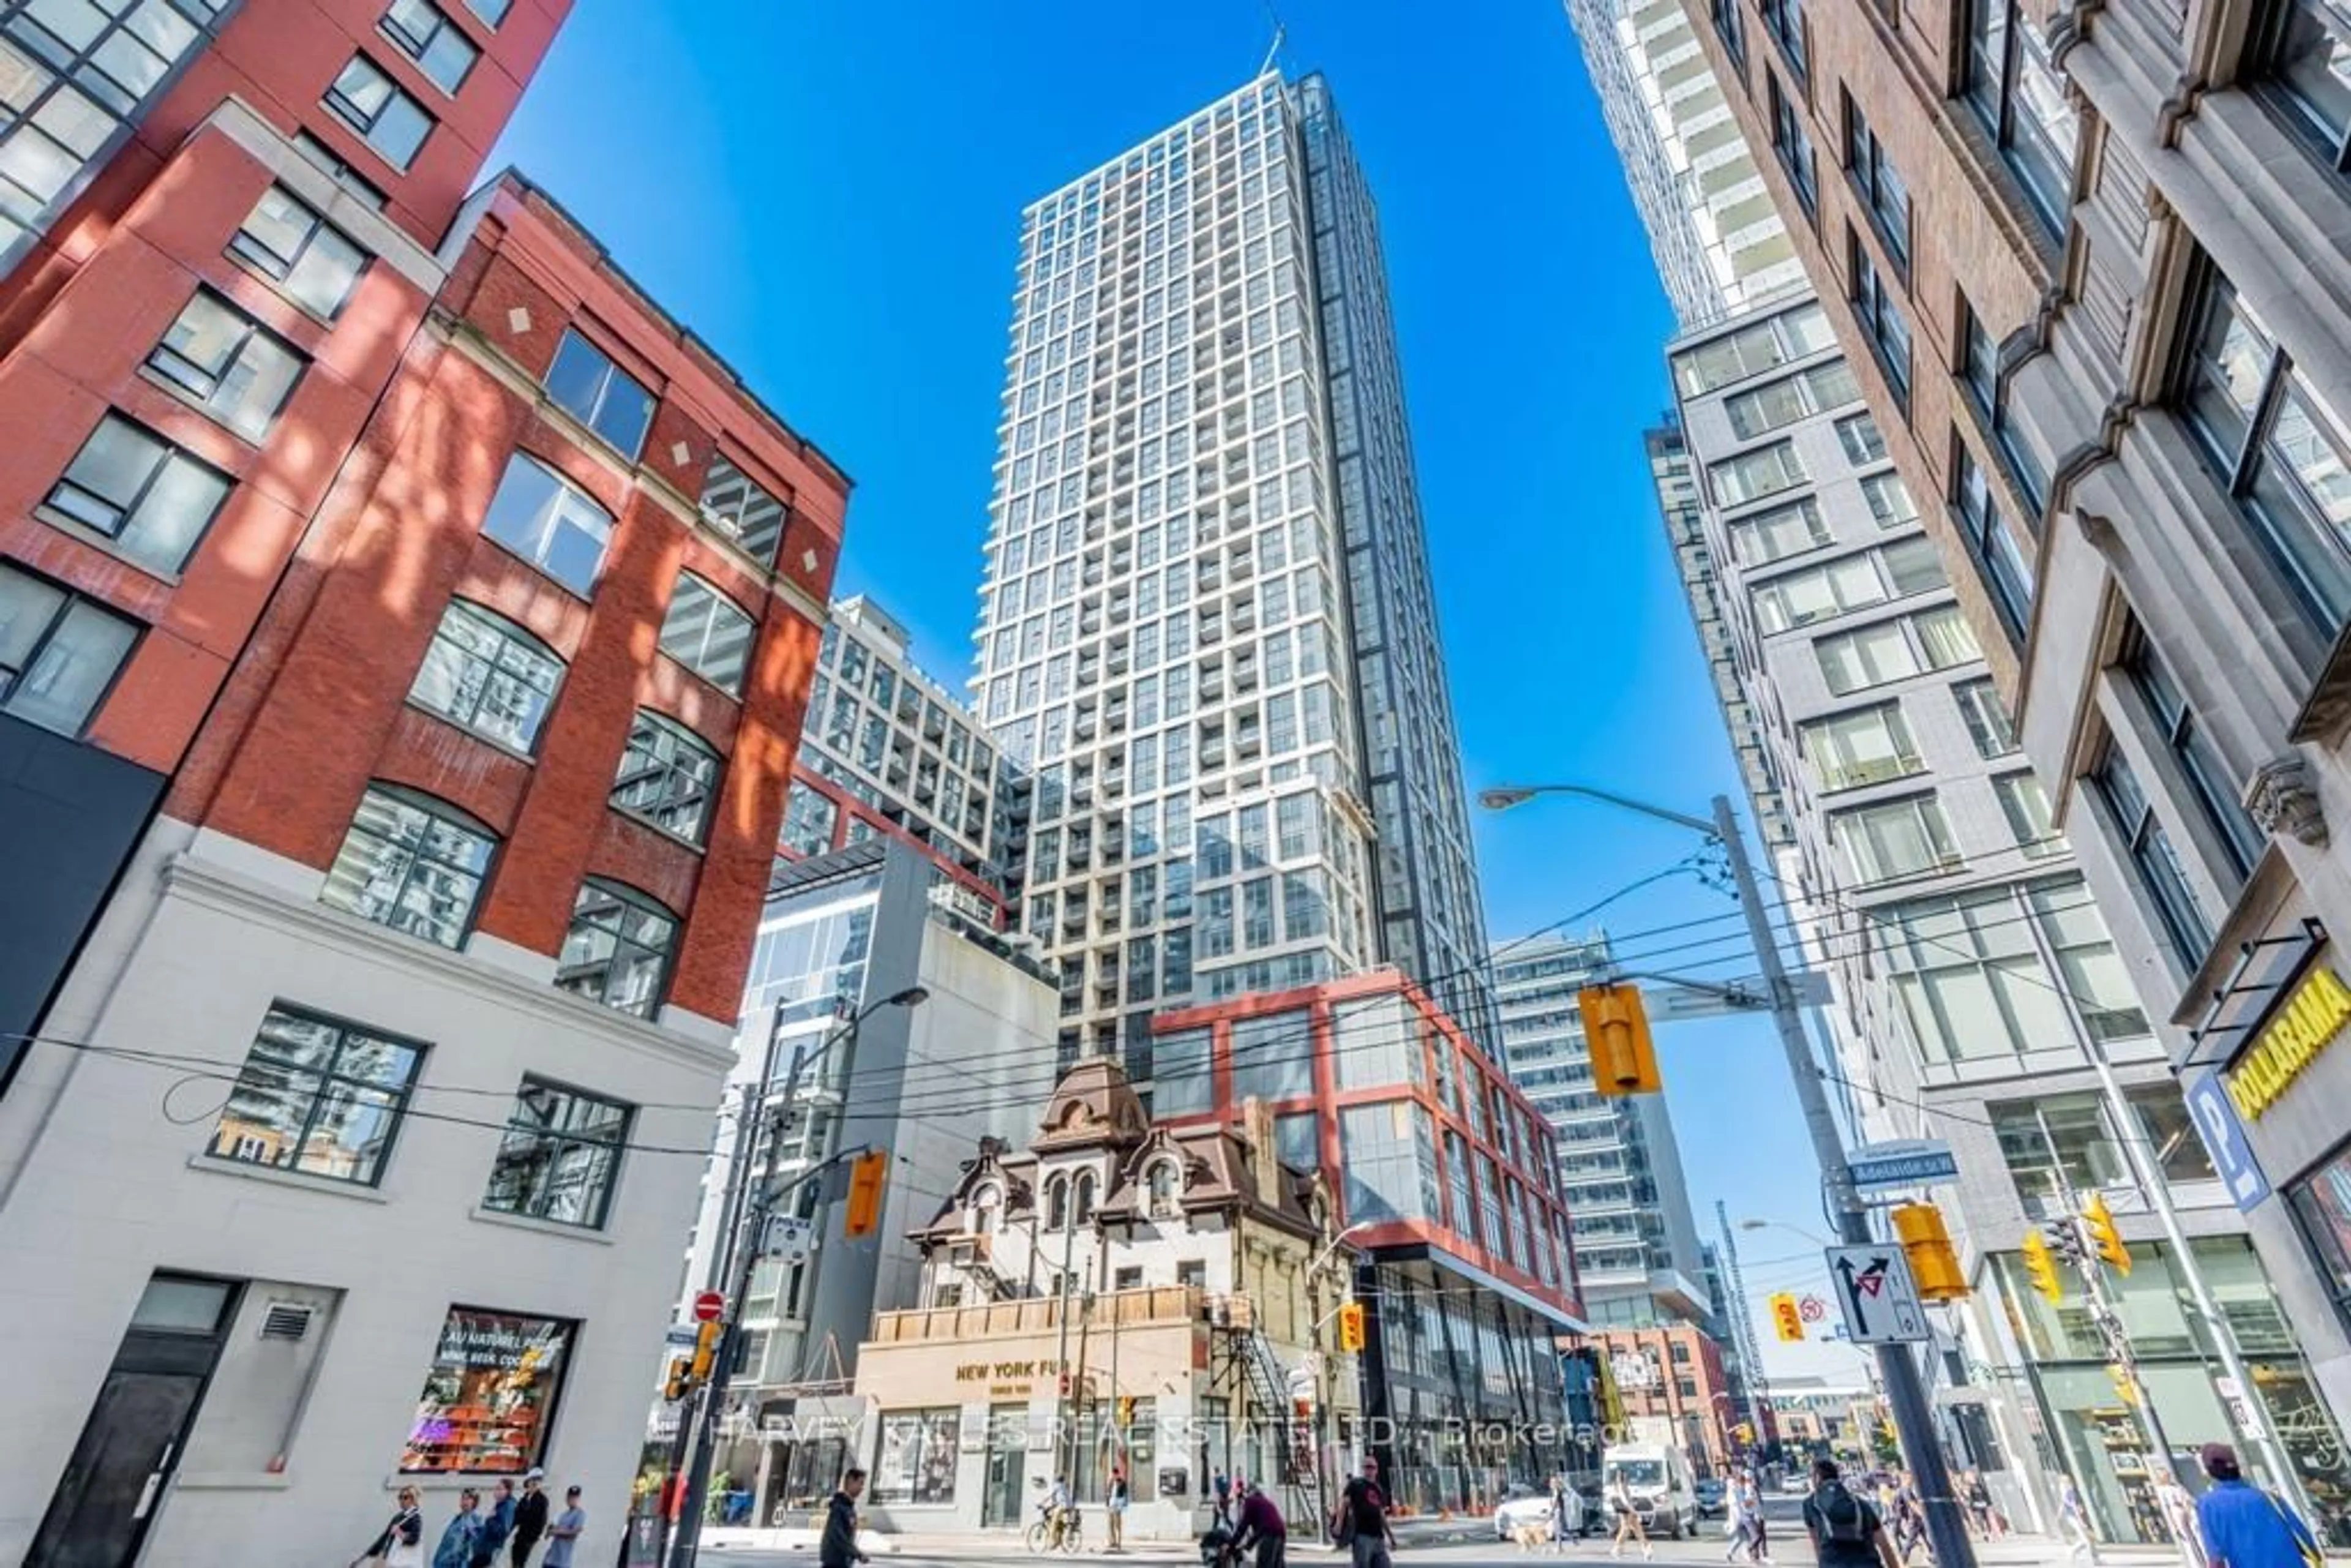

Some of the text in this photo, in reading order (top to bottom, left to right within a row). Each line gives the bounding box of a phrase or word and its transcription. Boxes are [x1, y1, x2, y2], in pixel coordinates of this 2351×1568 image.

[2228, 967, 2351, 1120] DOLLARAMA
[2198, 1090, 2236, 1171] P
[956, 1364, 988, 1381] NEW
[994, 1360, 1035, 1379] YORK
